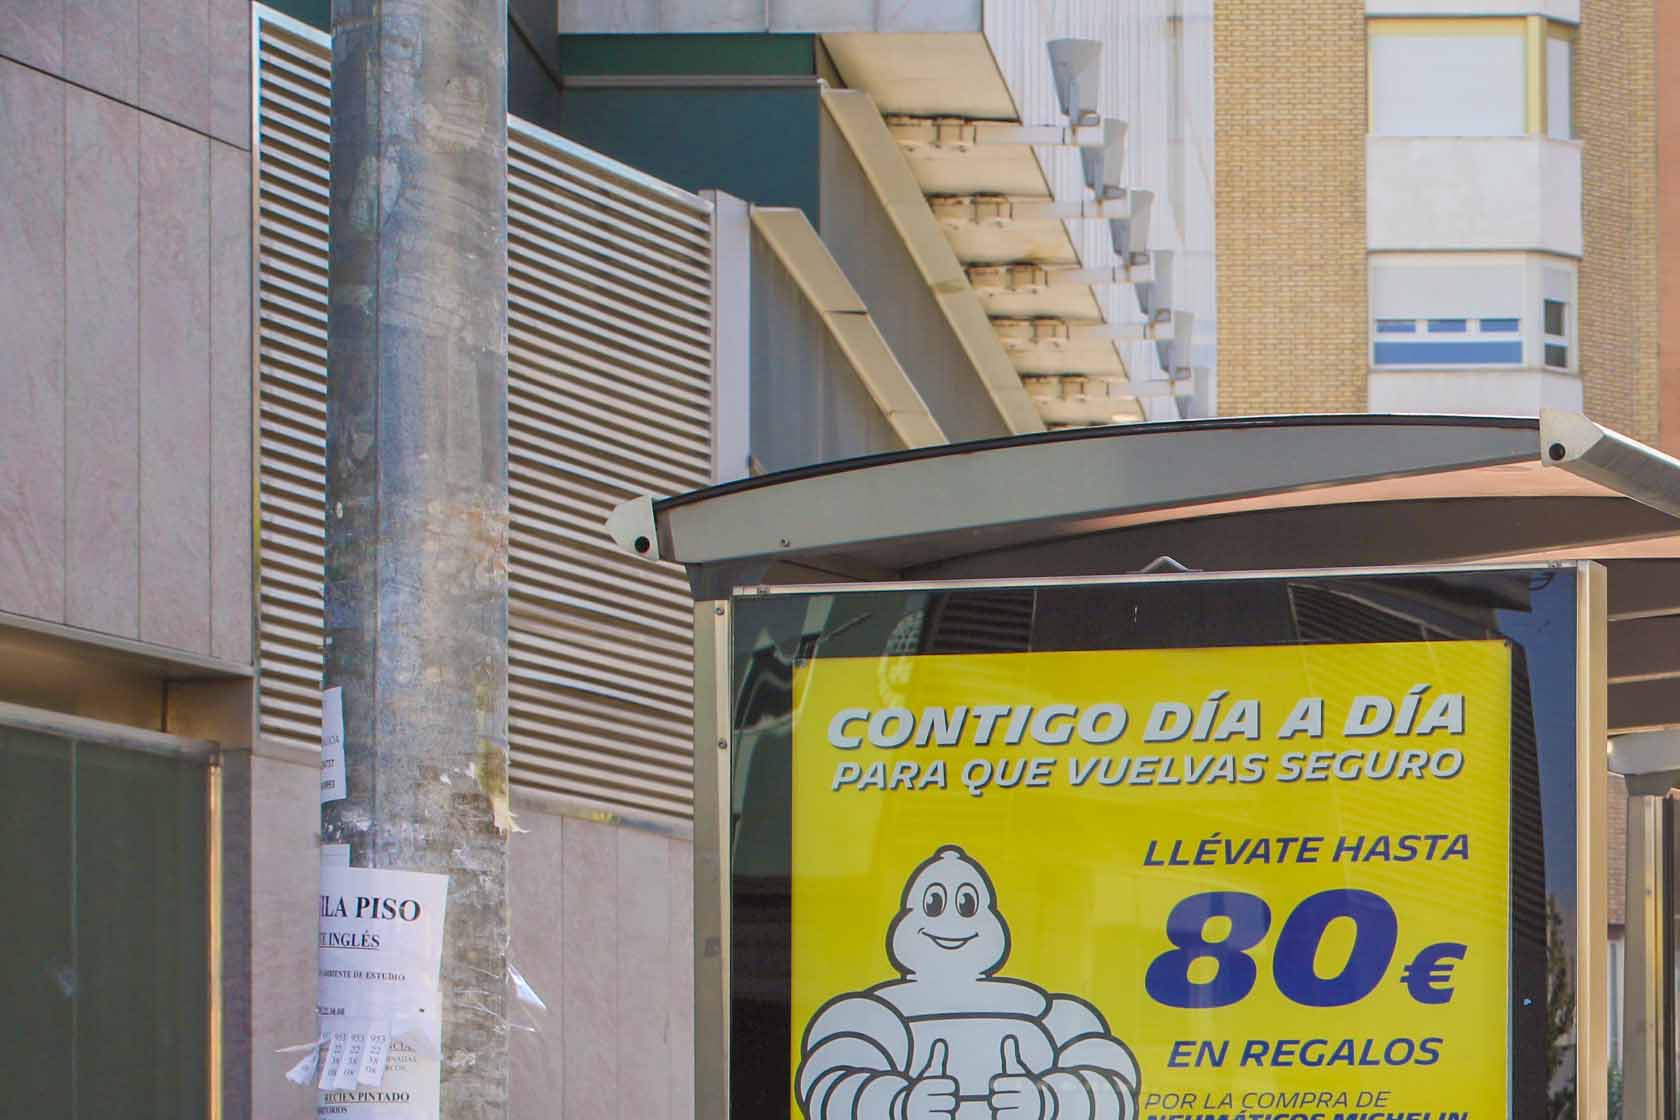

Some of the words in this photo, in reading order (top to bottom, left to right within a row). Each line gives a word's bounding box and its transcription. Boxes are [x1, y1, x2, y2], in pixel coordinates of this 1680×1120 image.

[826, 704, 1129, 750] CONTIGO
[1142, 690, 1261, 743] DÍA
[1277, 697, 1324, 739] A
[1344, 683, 1465, 737] DÍA
[831, 760, 948, 791] PARA
[960, 758, 1057, 798] QUE
[1067, 752, 1268, 787] VUELVAS
[1276, 750, 1465, 783] SEGURO
[1143, 832, 1325, 867] LLÉVATE
[1332, 833, 1470, 863] HASTA
[355, 896, 422, 921] PISO
[329, 930, 380, 948] INGLÉS
[1167, 1040, 1229, 1068] EN
[1239, 1038, 1443, 1067] REGALOS
[358, 1091, 410, 1102] PINTADO
[1144, 1093, 1197, 1110] POR
[1203, 1092, 1233, 1109] LA
[1241, 1091, 1348, 1109] COMPRA
[1356, 1090, 1392, 1108] DE
